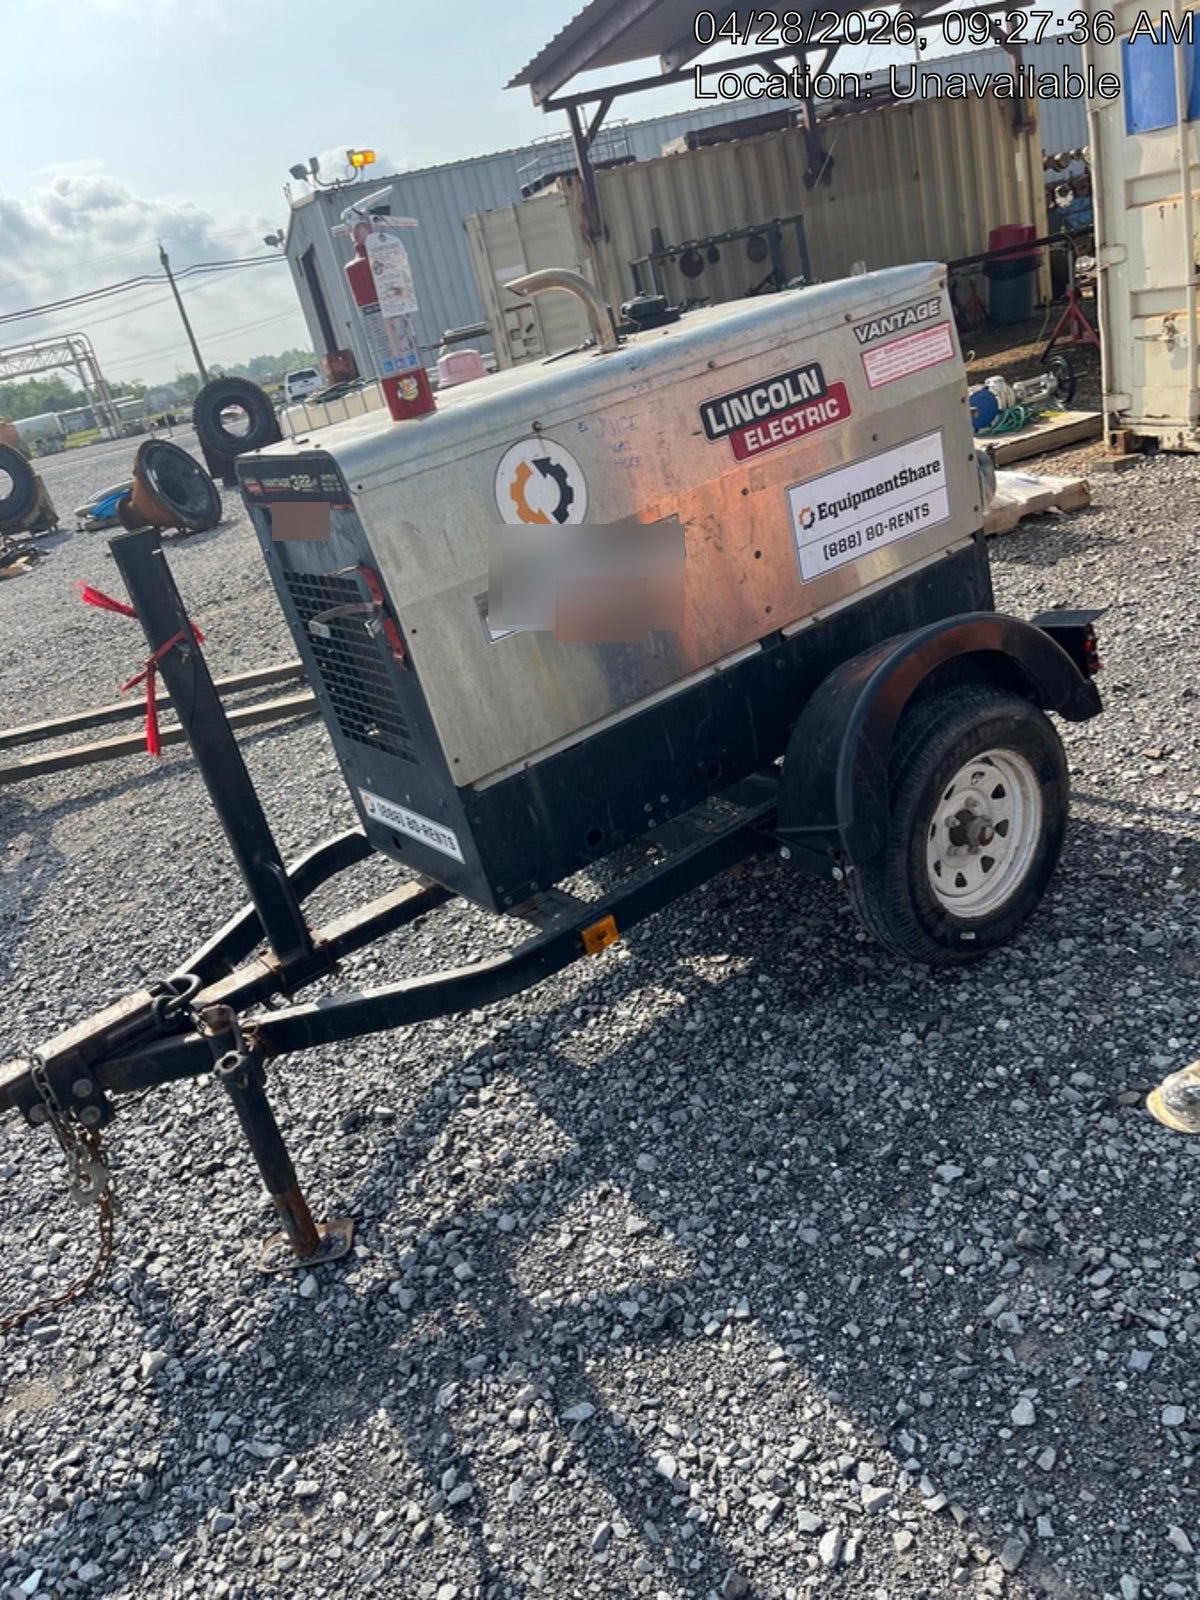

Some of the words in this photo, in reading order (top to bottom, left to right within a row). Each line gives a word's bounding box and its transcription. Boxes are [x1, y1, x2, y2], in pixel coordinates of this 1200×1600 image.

[853, 298, 941, 344] VANTAGE
[706, 368, 822, 434] LINCOLN
[743, 397, 841, 452] ELECTRIC
[817, 459, 941, 521] EquipmentShare
[822, 530, 862, 560] (888)
[865, 503, 930, 541] 80-RENTS
